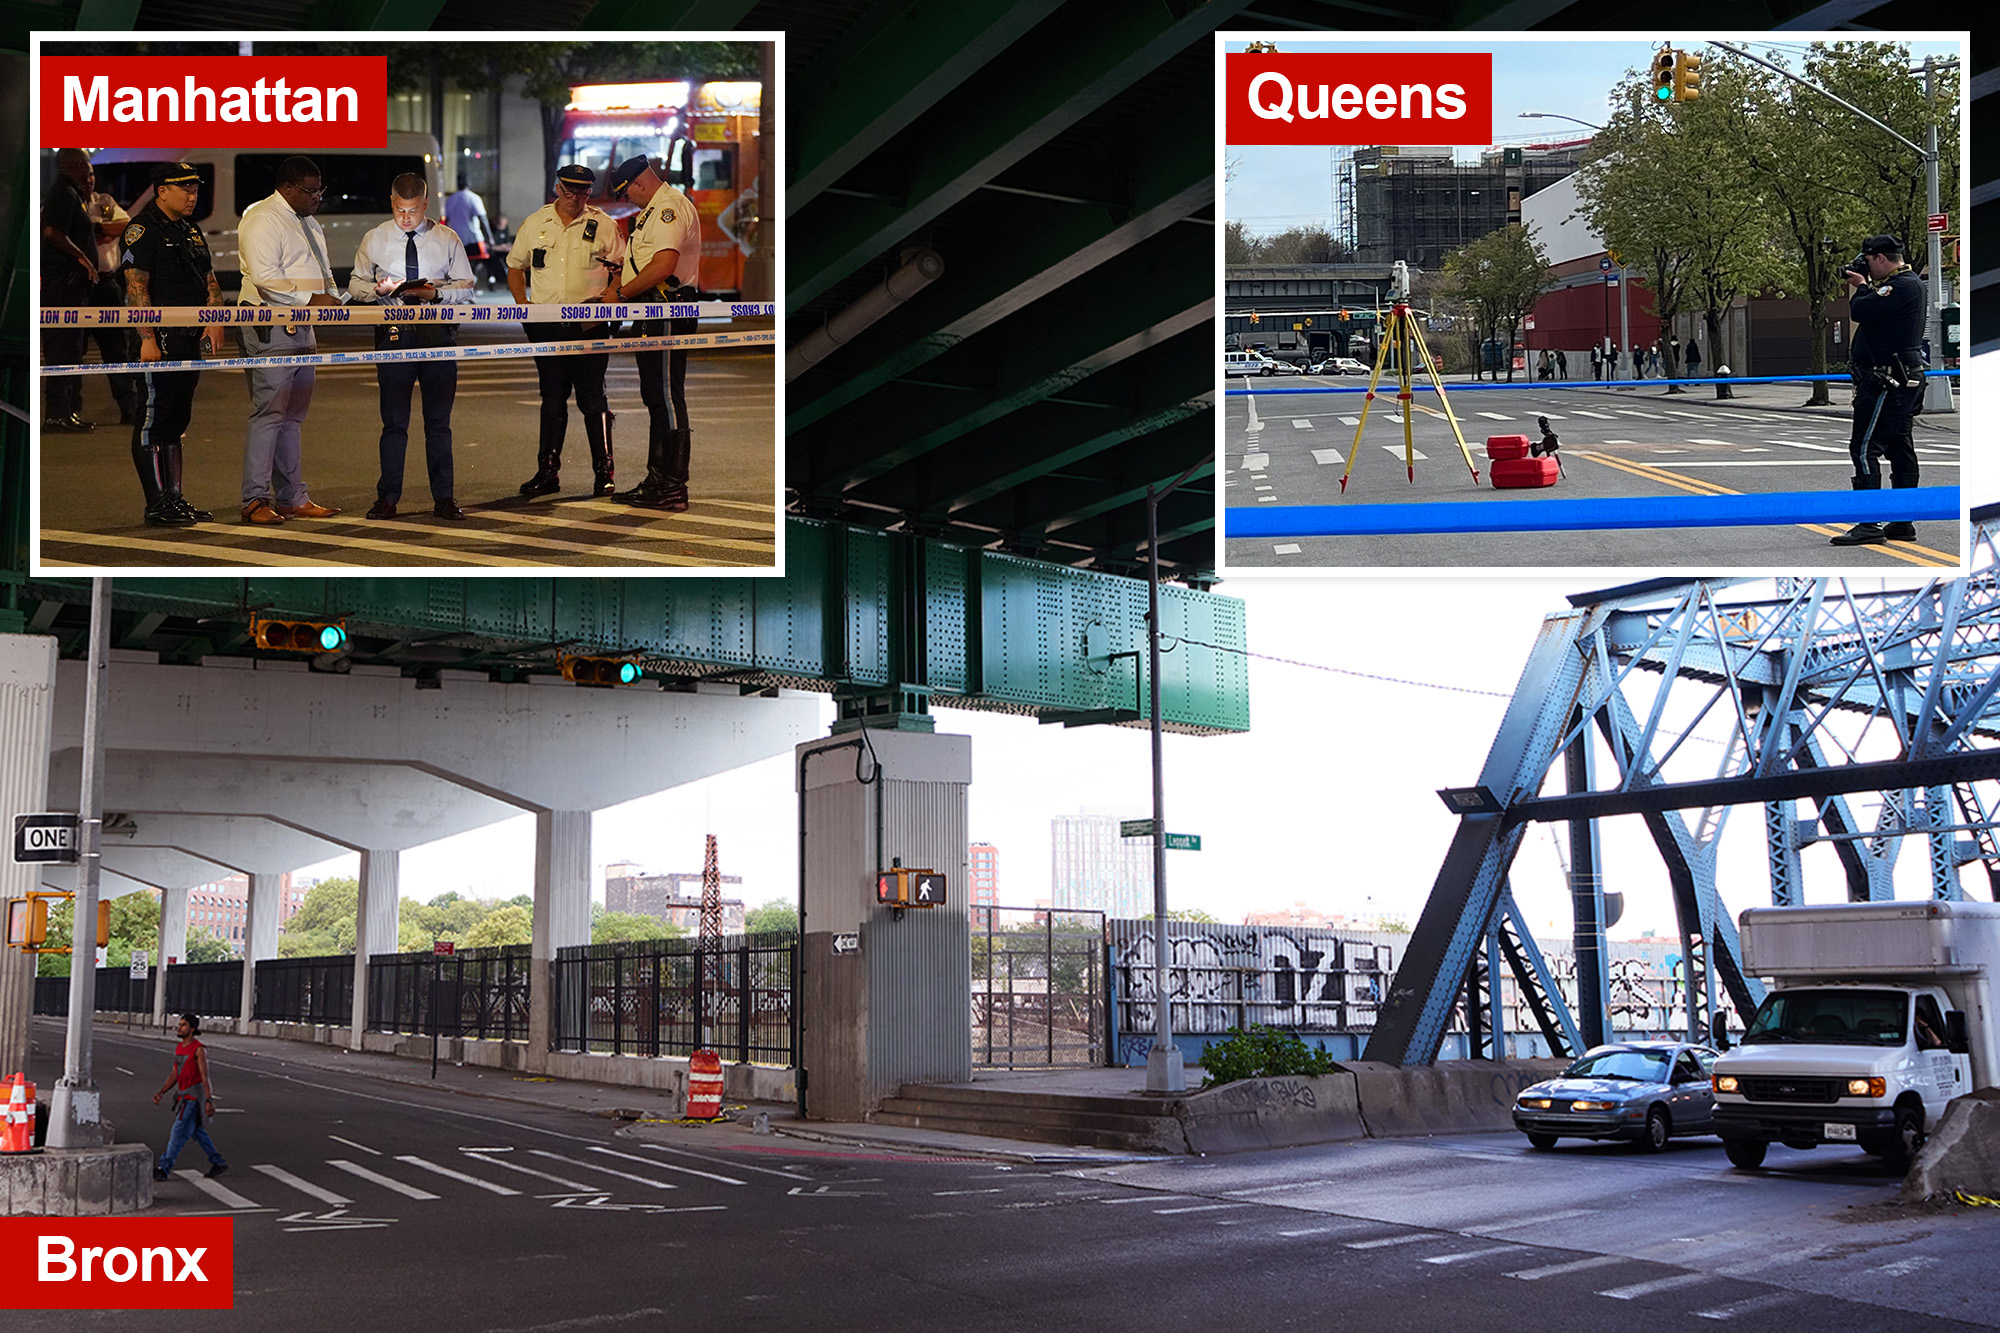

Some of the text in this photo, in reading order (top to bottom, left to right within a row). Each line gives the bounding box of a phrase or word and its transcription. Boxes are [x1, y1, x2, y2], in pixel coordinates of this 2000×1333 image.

[198, 310, 231, 322] CROSS
[234, 310, 254, 322] NOT
[258, 310, 272, 322] DO
[290, 309, 310, 322] LINE
[317, 308, 350, 321] POLICE
[384, 308, 416, 320] CROSS
[418, 308, 436, 320] NOT
[440, 308, 454, 320] DO
[472, 308, 490, 320] LINE
[497, 307, 528, 320] POLICE
[561, 306, 591, 319] CROSS
[594, 306, 612, 318] NOT
[616, 306, 628, 318] DO
[645, 306, 663, 318] LINE
[670, 305, 700, 318] POLICE
[731, 304, 760, 316] CROSS
[64, 310, 78, 324] DO
[98, 310, 120, 324] LINE
[127, 309, 162, 324] POLICE
[30, 830, 68, 847] ONE
[132, 961, 146, 970] 25
